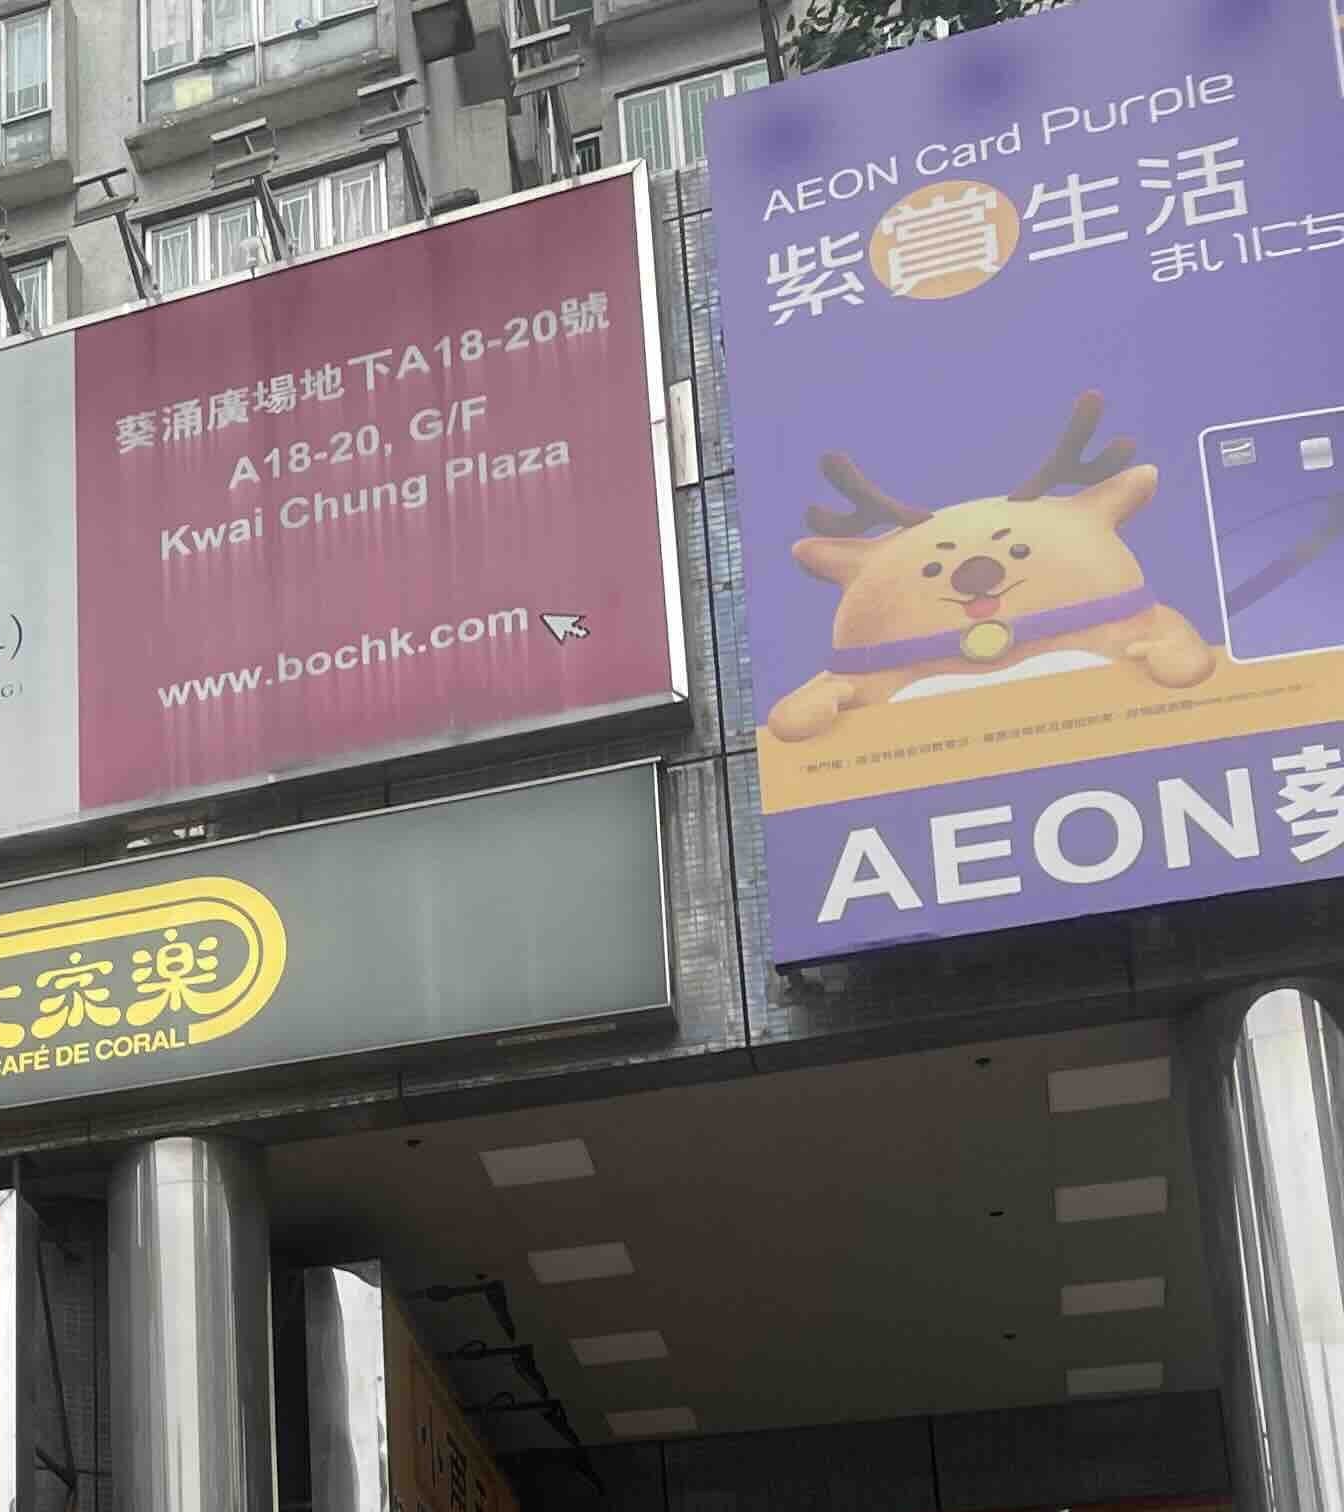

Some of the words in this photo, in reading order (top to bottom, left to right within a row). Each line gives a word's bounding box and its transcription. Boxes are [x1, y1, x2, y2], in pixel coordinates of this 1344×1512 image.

[763, 157, 899, 221] AEON
[915, 123, 1023, 177] Card
[1041, 72, 1237, 144] Purple
[767, 136, 1249, 325] 紫賞生活
[115, 291, 610, 454] 葵涌廣場地下A18-20號
[159, 508, 265, 561] Kwai
[279, 473, 429, 531] Chung
[444, 438, 570, 493] Plaza
[228, 426, 393, 490] A18-20,
[408, 396, 489, 442] G/F
[157, 606, 529, 709] www.bochk.com
[55, 1045, 90, 1069] DE
[95, 1027, 186, 1060] CORAL
